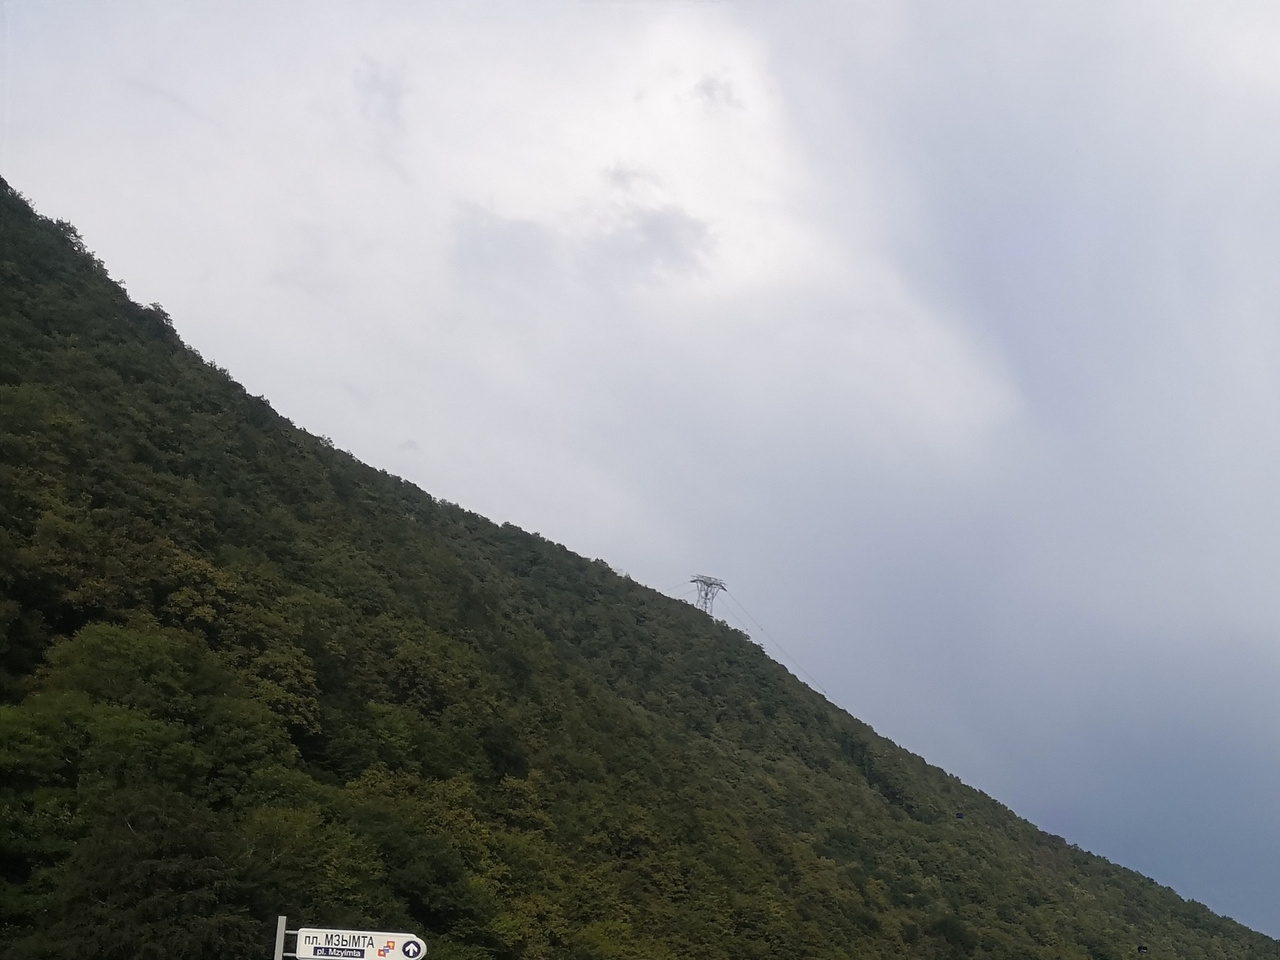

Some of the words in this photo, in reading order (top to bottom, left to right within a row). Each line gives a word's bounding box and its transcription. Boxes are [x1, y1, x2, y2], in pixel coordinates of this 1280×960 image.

[304, 935, 321, 946] пл.
[325, 933, 375, 949] МЗЫМТА
[317, 948, 326, 956] pl.
